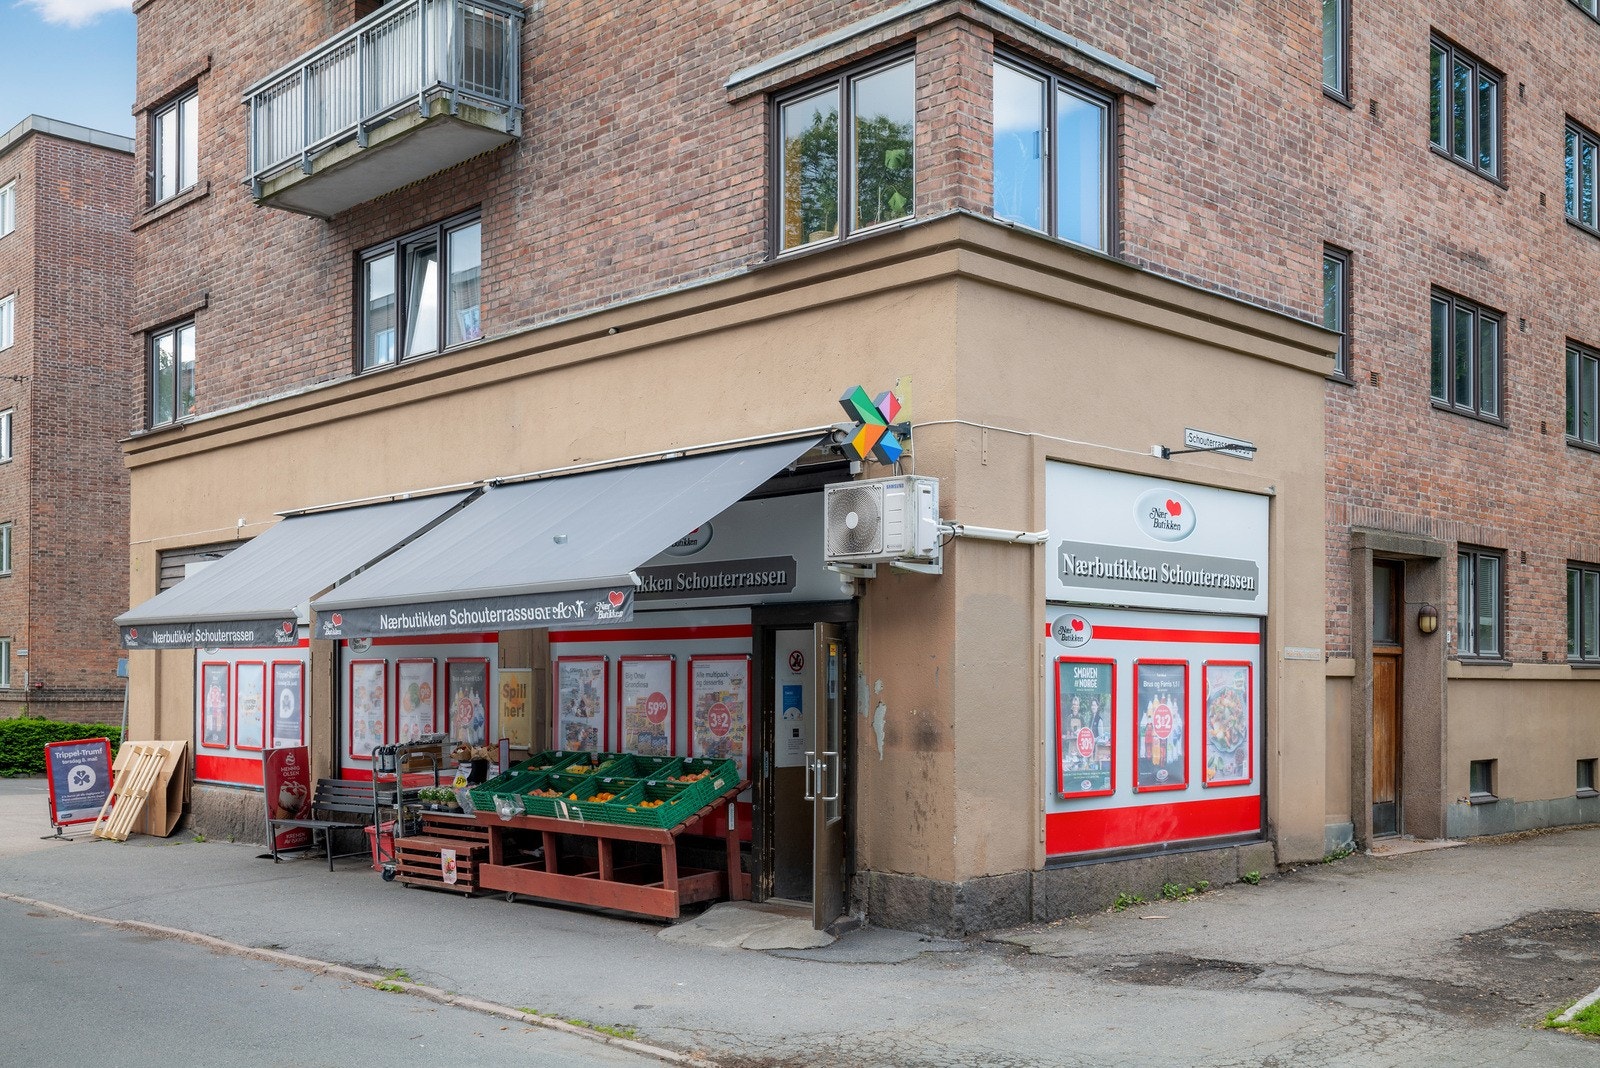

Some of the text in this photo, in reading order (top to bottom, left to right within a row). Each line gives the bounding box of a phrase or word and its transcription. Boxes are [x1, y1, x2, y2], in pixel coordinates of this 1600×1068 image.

[1149, 507, 1168, 519] Nær
[1153, 518, 1181, 531] Butikken
[1062, 552, 1255, 591] Nærbutikken Schouterrassen
[677, 569, 788, 591] Schouterrassen
[380, 611, 447, 630] Nærbutikken
[195, 629, 254, 643] Schouterrassen
[1061, 634, 1084, 642] Butikken
[1073, 666, 1098, 679] SMAKEN
[1079, 679, 1098, 688] NORGE
[502, 683, 527, 701] Spill
[504, 702, 525, 718] her!
[55, 748, 103, 759] Trippel-Trumf
[62, 757, 82, 765] torsdag
